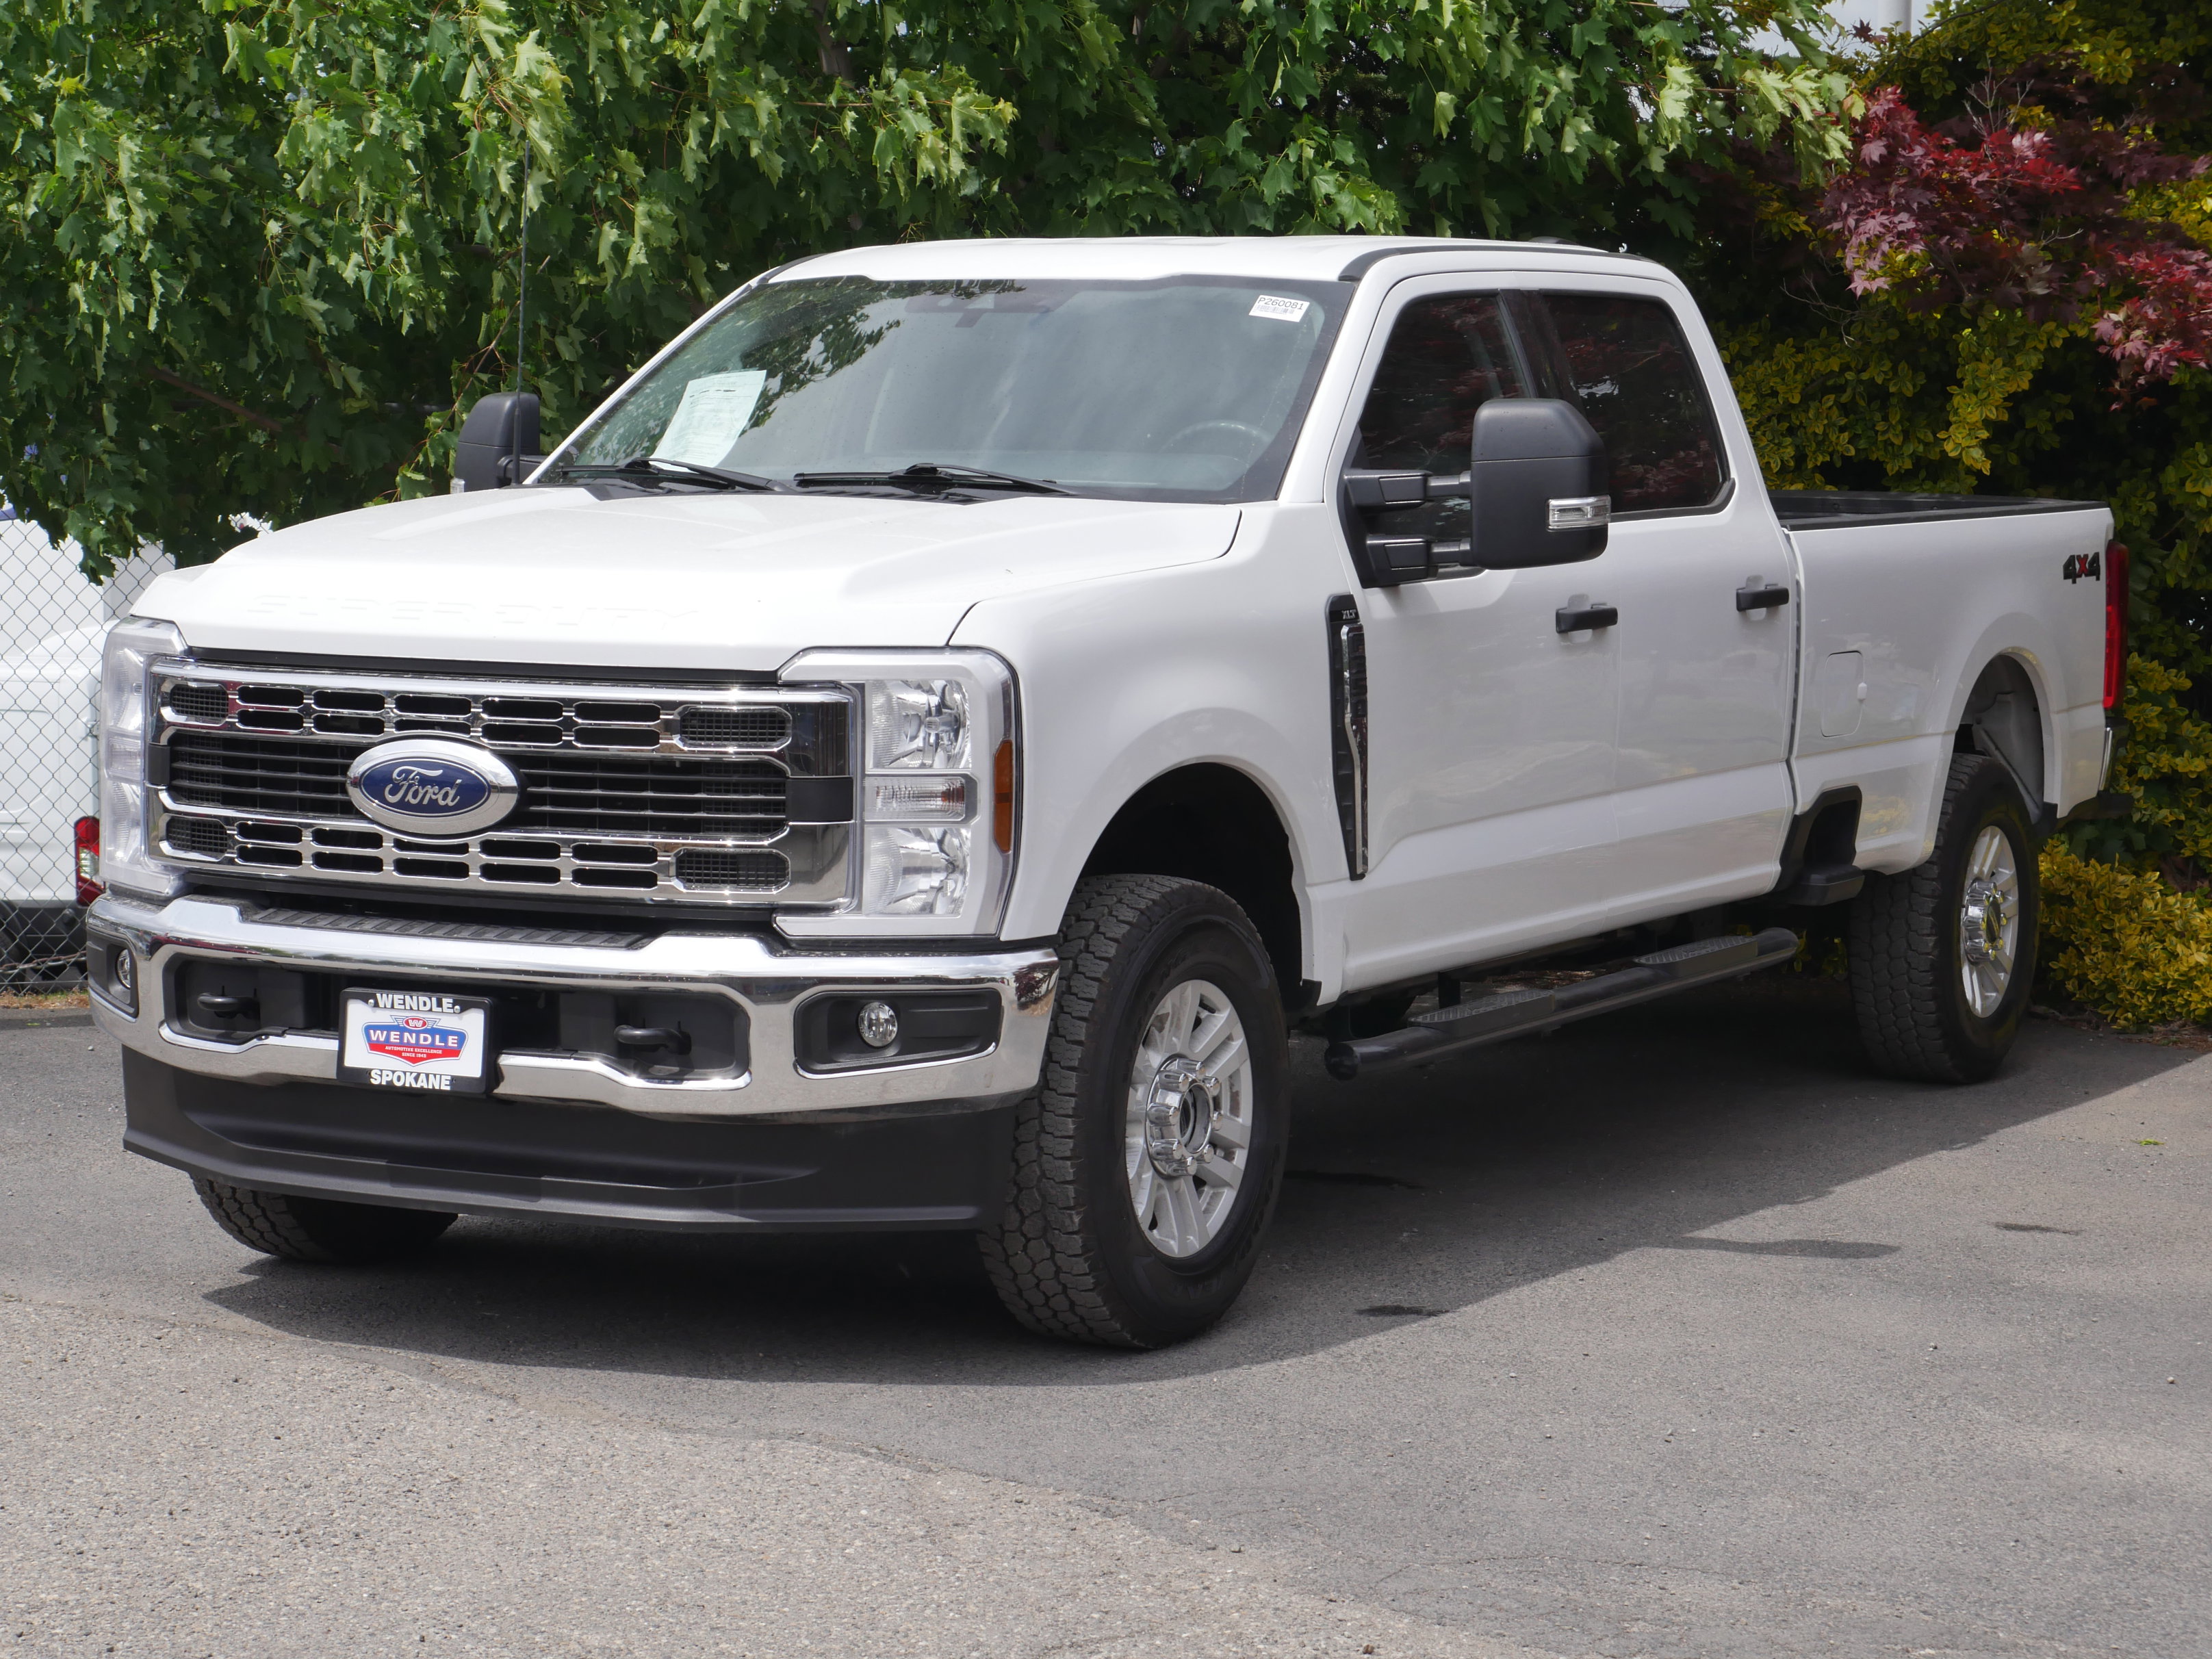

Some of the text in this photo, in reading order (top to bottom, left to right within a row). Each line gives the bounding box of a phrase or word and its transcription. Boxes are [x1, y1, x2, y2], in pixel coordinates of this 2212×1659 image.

[1257, 297, 1304, 310] P260081
[246, 594, 699, 630] SUPER DUTY
[1341, 609, 1356, 619] XLT
[385, 766, 461, 807] Ford
[376, 993, 454, 1013] WENDLE
[370, 1029, 459, 1047] WENDLE
[370, 1070, 451, 1090] SPOKANE
